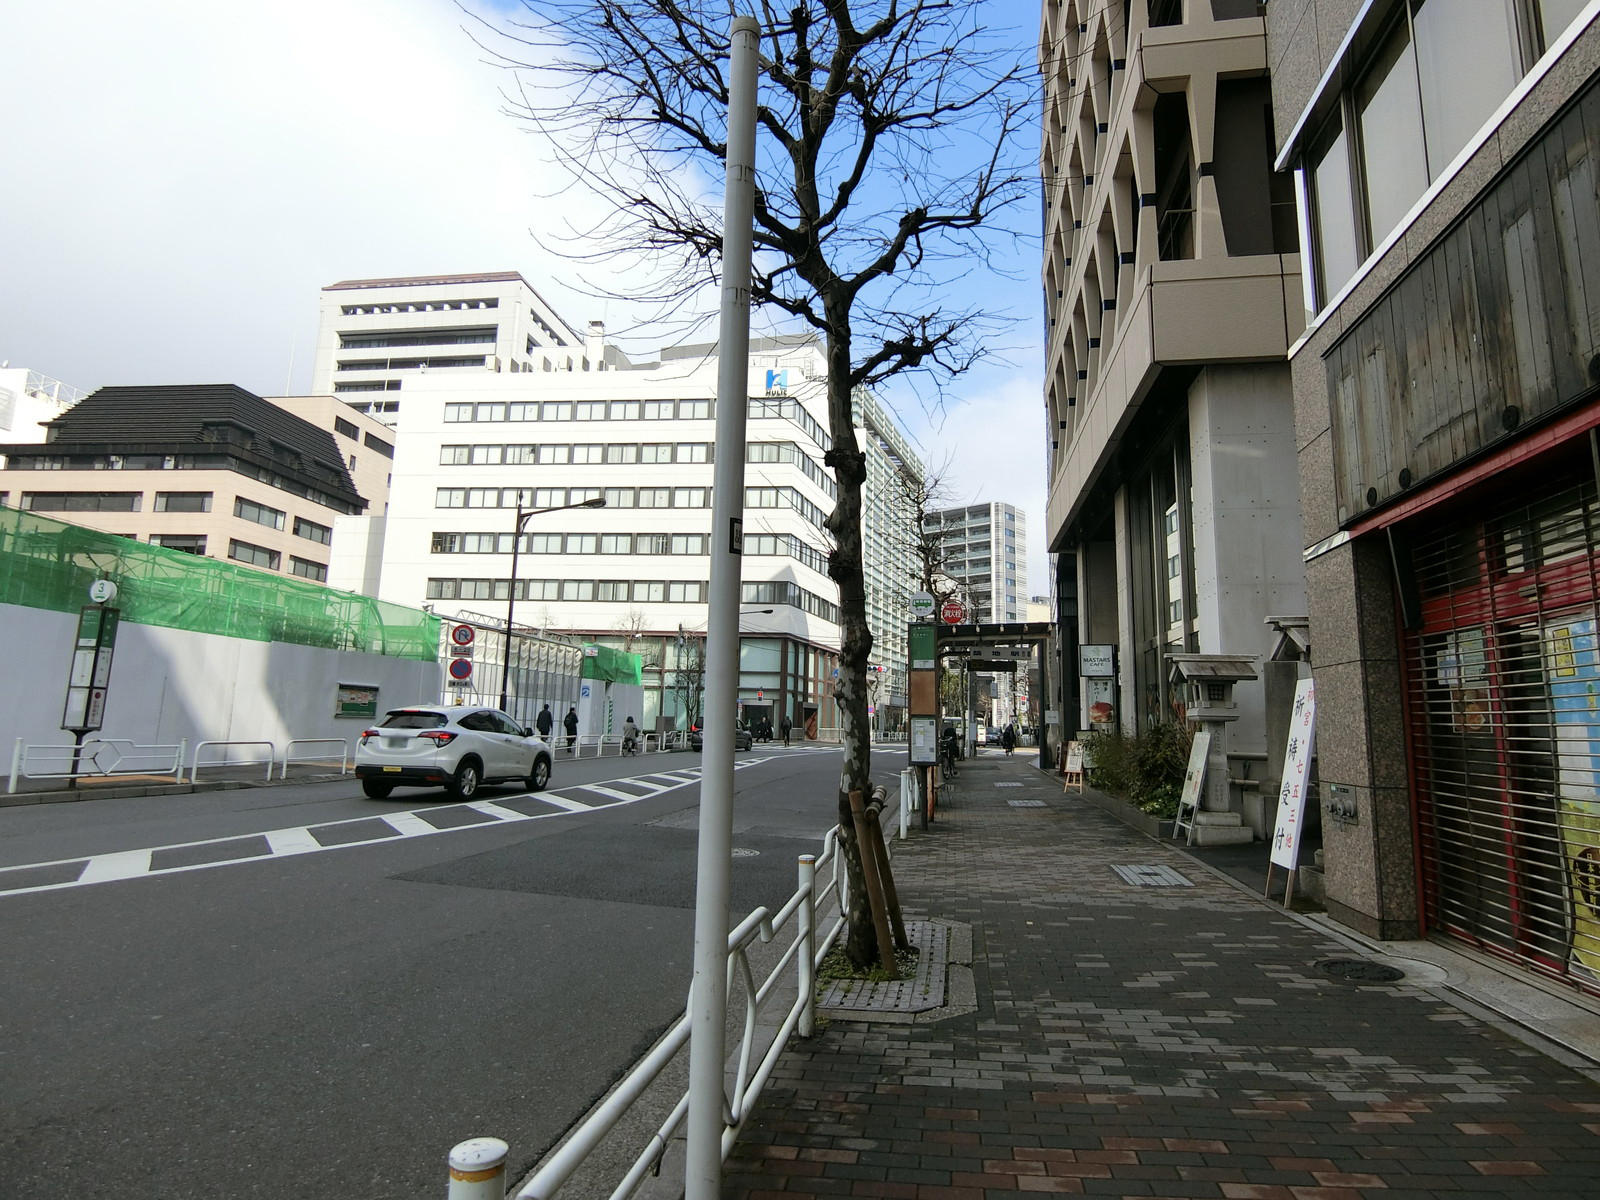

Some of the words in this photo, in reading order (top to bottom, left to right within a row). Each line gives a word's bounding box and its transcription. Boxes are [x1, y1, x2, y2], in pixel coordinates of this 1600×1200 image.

[98, 582, 105, 593] 3
[943, 609, 961, 618] 消火栓
